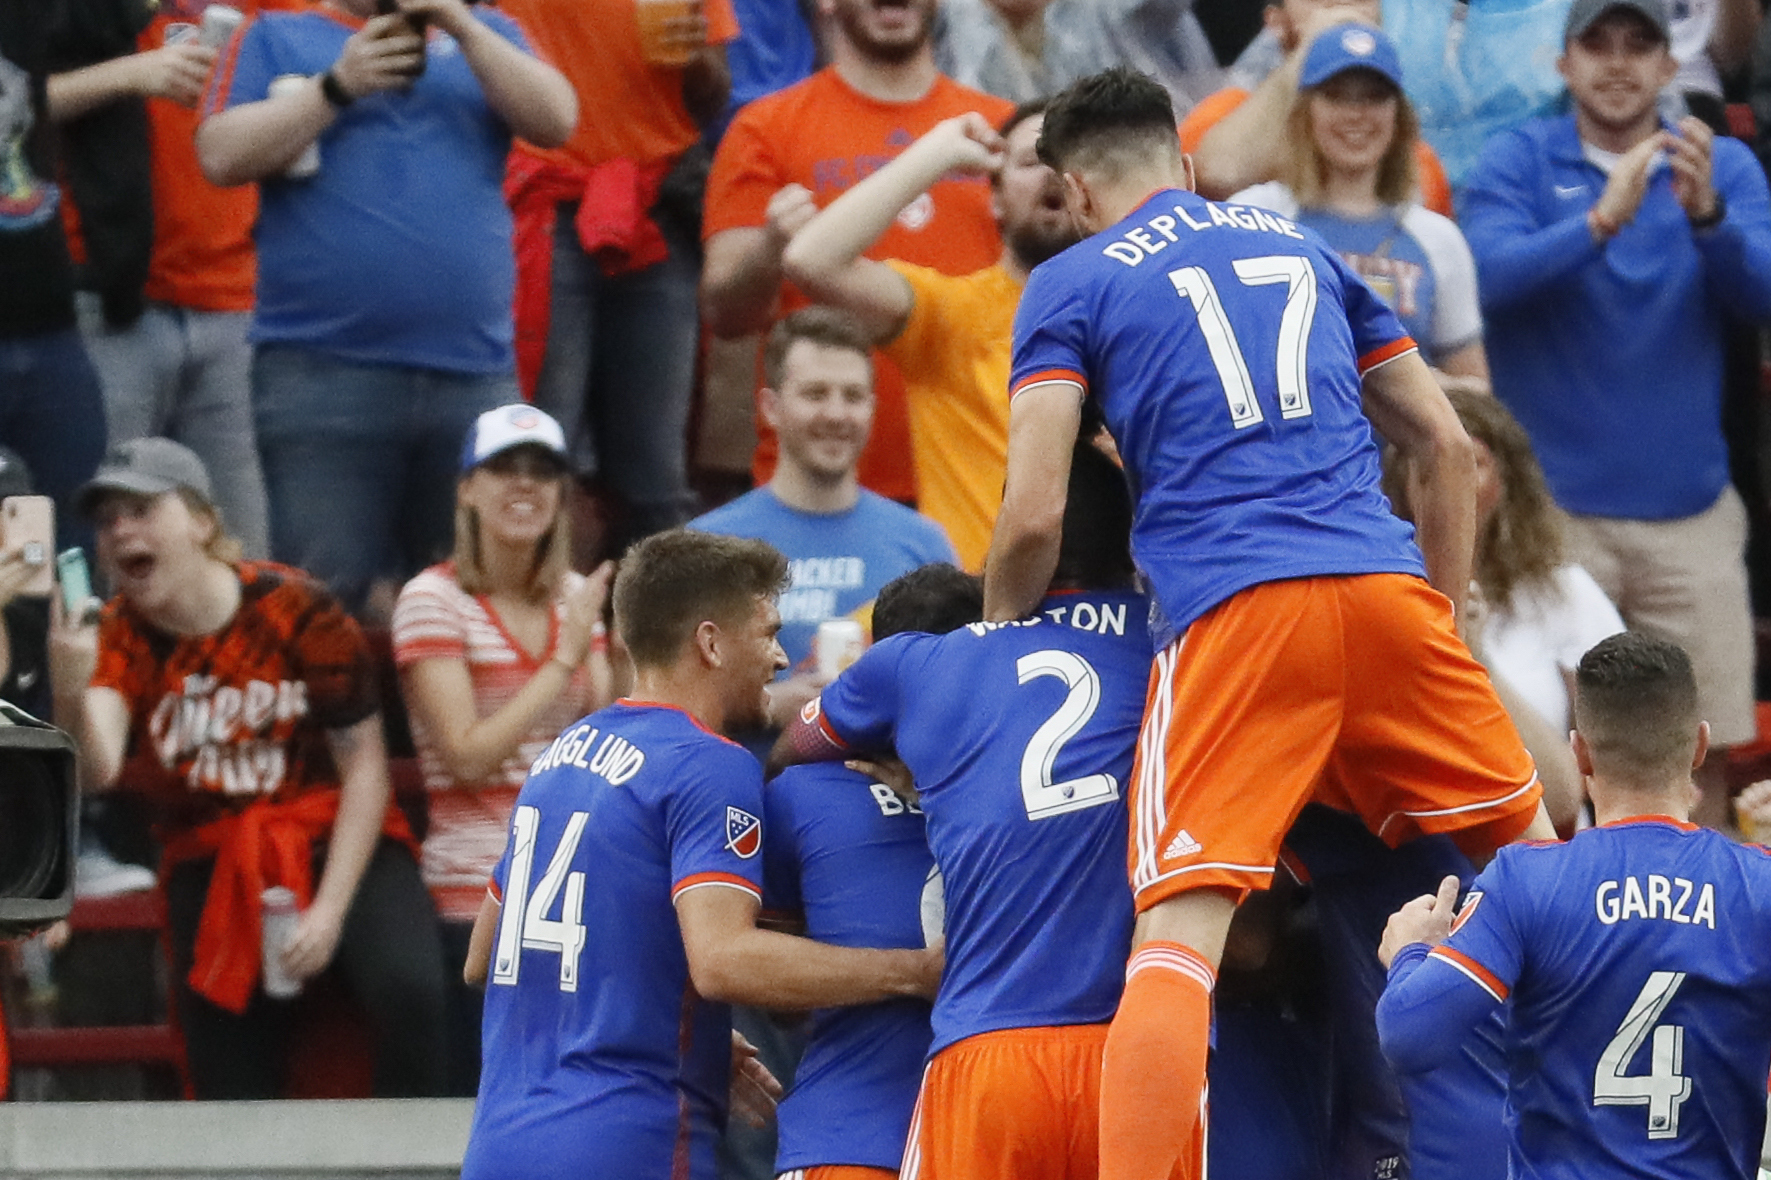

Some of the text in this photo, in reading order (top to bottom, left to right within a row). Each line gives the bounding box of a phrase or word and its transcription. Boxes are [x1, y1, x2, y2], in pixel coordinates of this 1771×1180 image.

[1102, 202, 1304, 267] DEPLAGNE
[1168, 255, 1318, 430] 17
[1016, 649, 1120, 822] 2
[493, 805, 590, 993] 14
[1595, 874, 1716, 930] GARZA
[1593, 971, 1692, 1140] 4
